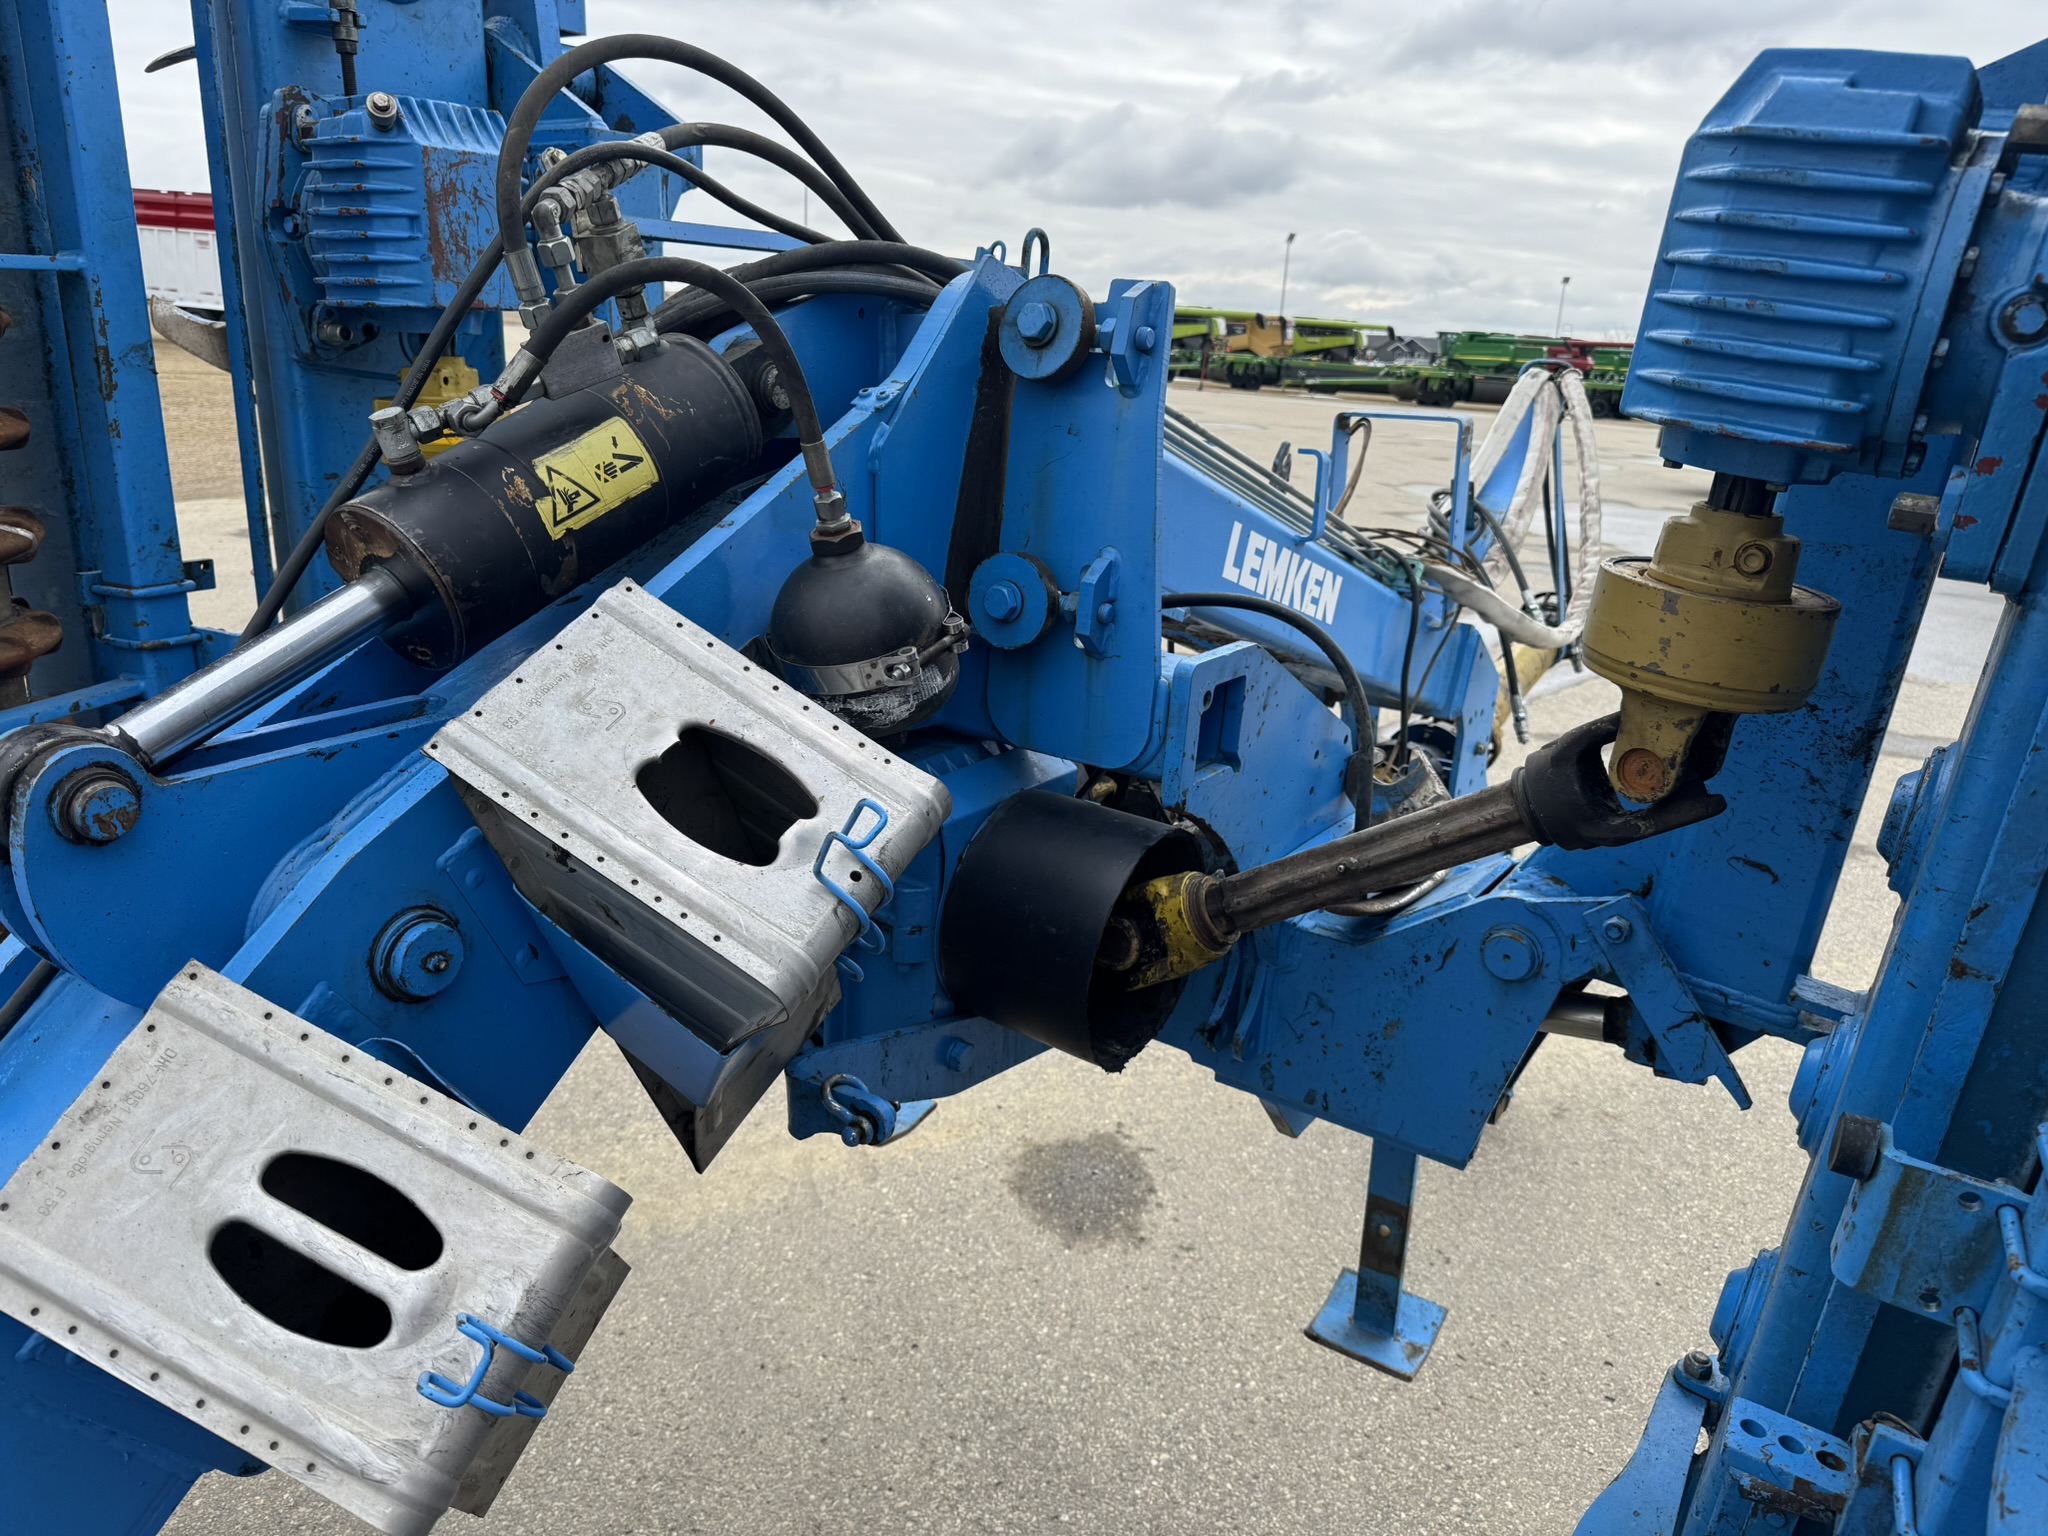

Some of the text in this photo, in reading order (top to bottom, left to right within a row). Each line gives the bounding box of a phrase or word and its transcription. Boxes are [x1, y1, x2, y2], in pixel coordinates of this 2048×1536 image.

[406, 380, 421, 398] MADE
[421, 359, 431, 373] USA
[1222, 520, 1343, 625] LEMKEN
[596, 632, 615, 650] DIN
